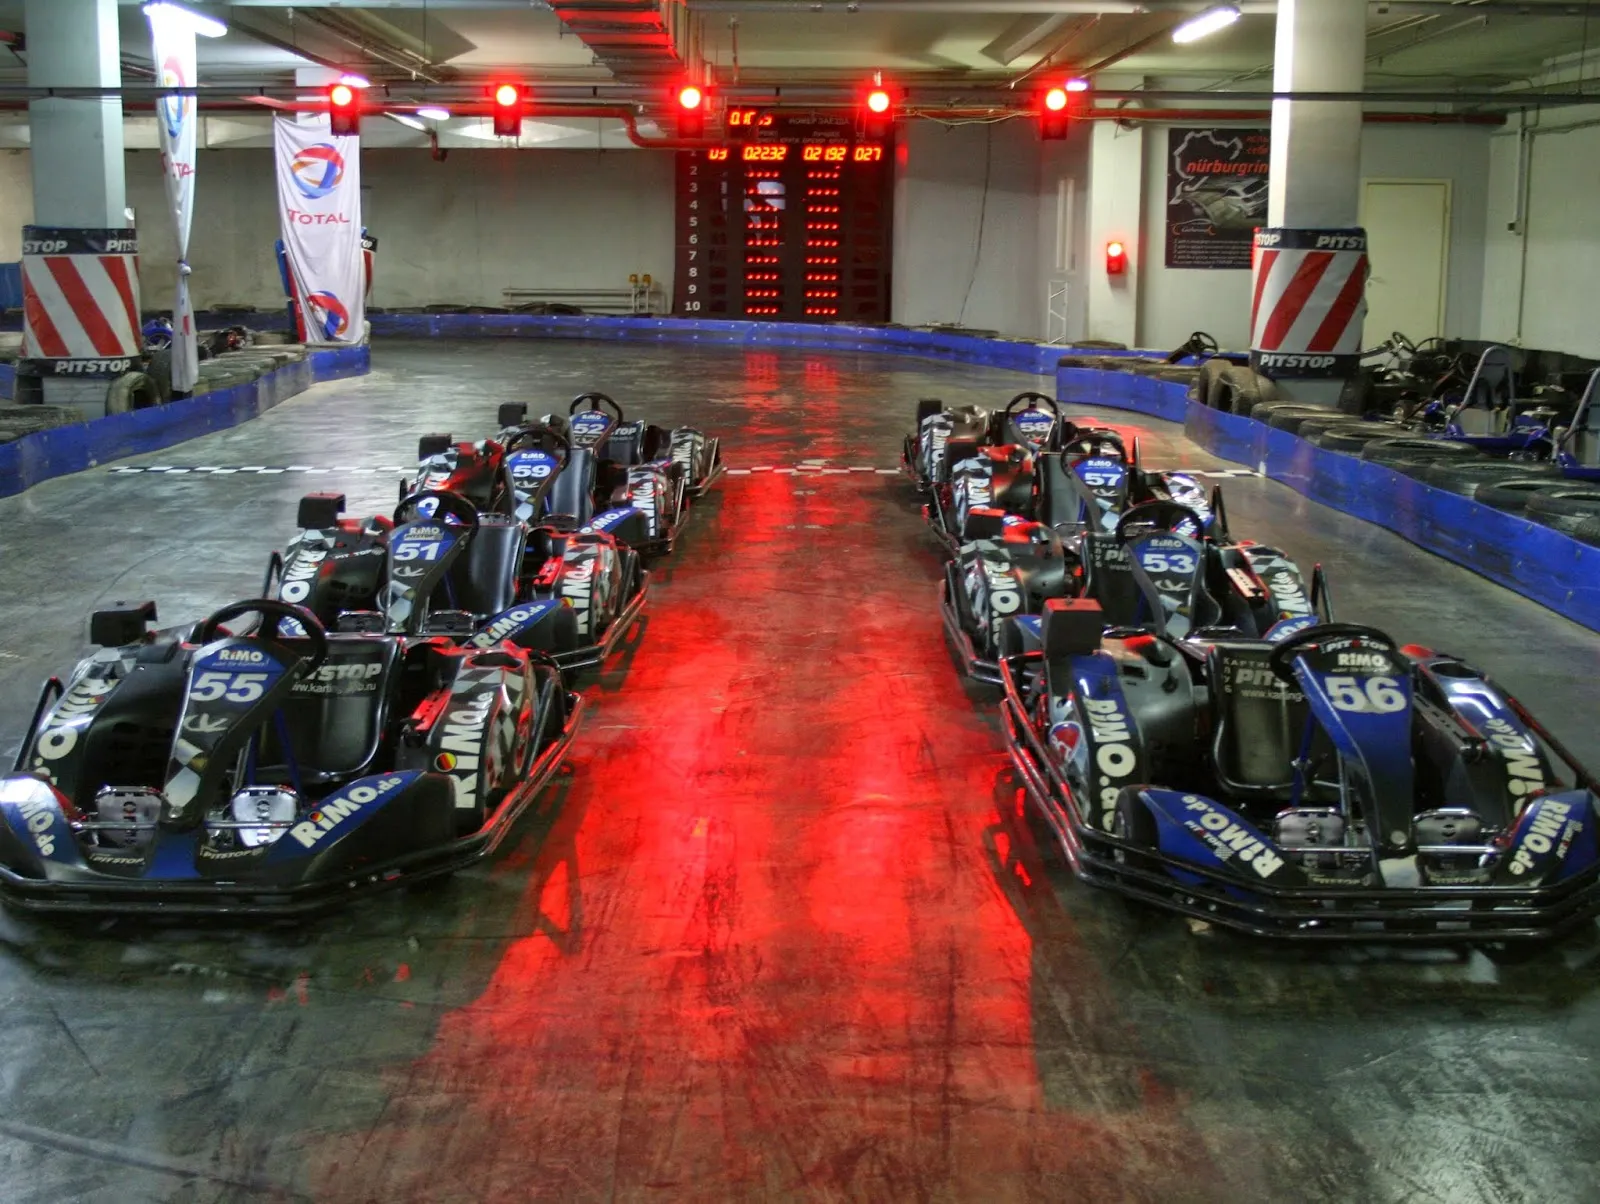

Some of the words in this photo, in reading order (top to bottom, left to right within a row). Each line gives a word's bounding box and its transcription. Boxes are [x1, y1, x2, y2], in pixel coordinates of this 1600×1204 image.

[690, 166, 698, 175] 2
[689, 183, 698, 192] 3
[689, 200, 698, 210] 4
[287, 209, 350, 225] TOTAL
[689, 217, 698, 226] 5
[689, 234, 698, 244] 6
[689, 251, 697, 260] 7
[689, 268, 697, 277] 8
[688, 285, 697, 294] 9
[685, 302, 700, 311] 10
[55, 359, 132, 374] PITSTOP
[1260, 353, 1336, 368] PITSTOP
[573, 423, 605, 435] 52
[513, 465, 551, 478] 59
[1084, 472, 1121, 486] 57
[394, 542, 440, 560] 51
[1143, 553, 1195, 574] 53
[190, 672, 268, 702] 55
[1324, 676, 1407, 714] 56
